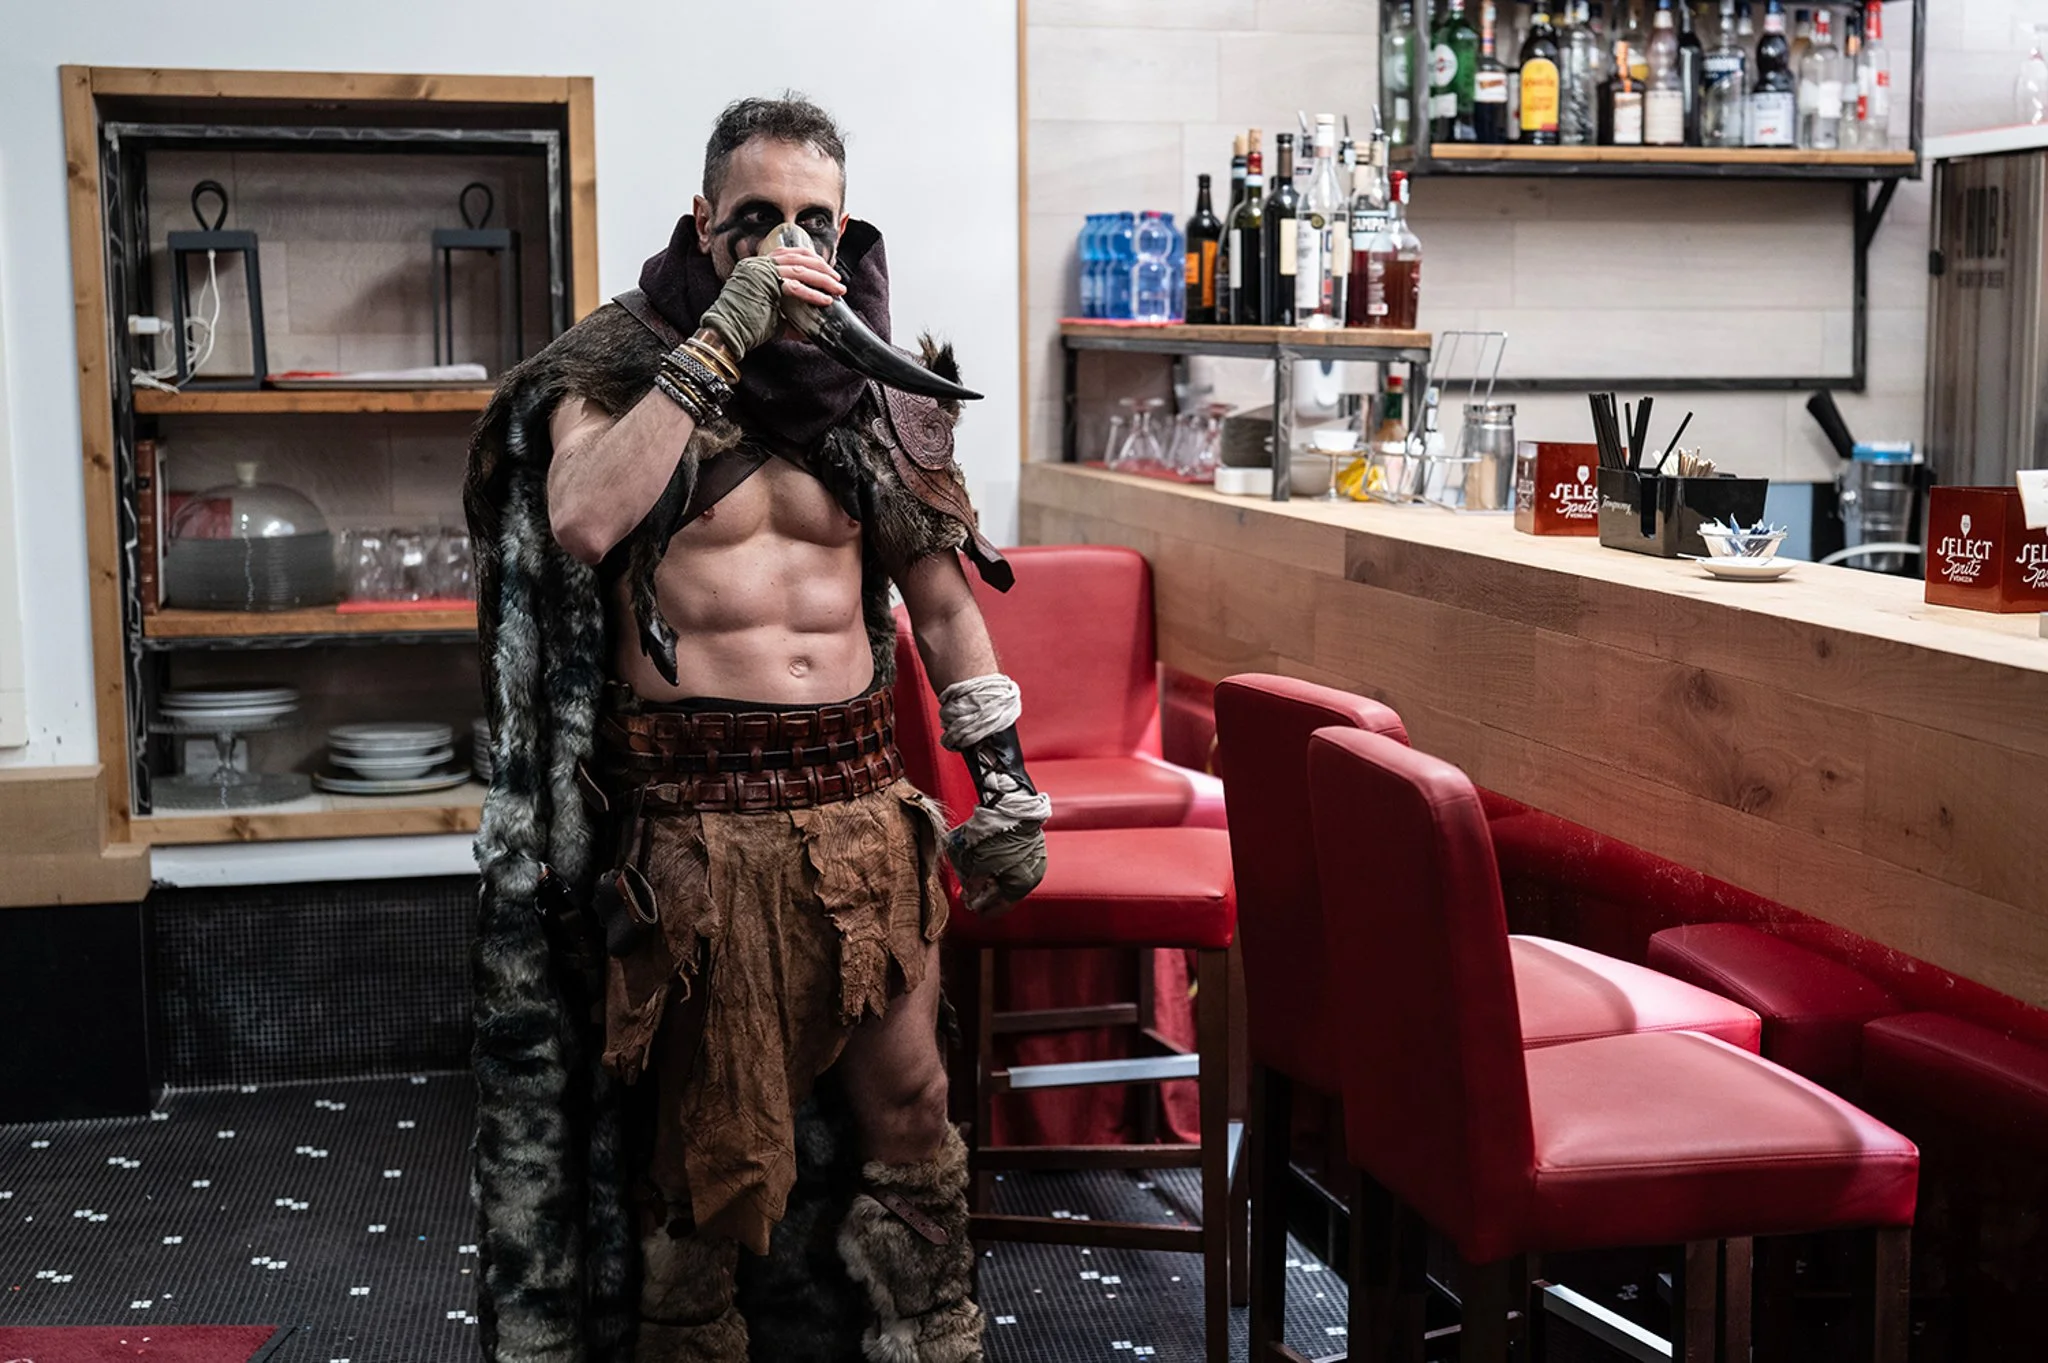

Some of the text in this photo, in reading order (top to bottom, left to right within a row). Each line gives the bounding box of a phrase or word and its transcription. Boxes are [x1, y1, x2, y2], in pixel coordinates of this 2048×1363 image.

[1351, 216, 1389, 232] CAMPA
[1549, 483, 1598, 500] SELEC
[1937, 536, 1992, 560] SELECT
[2015, 543, 2048, 563] SEL
[1941, 556, 1981, 581] Spritz
